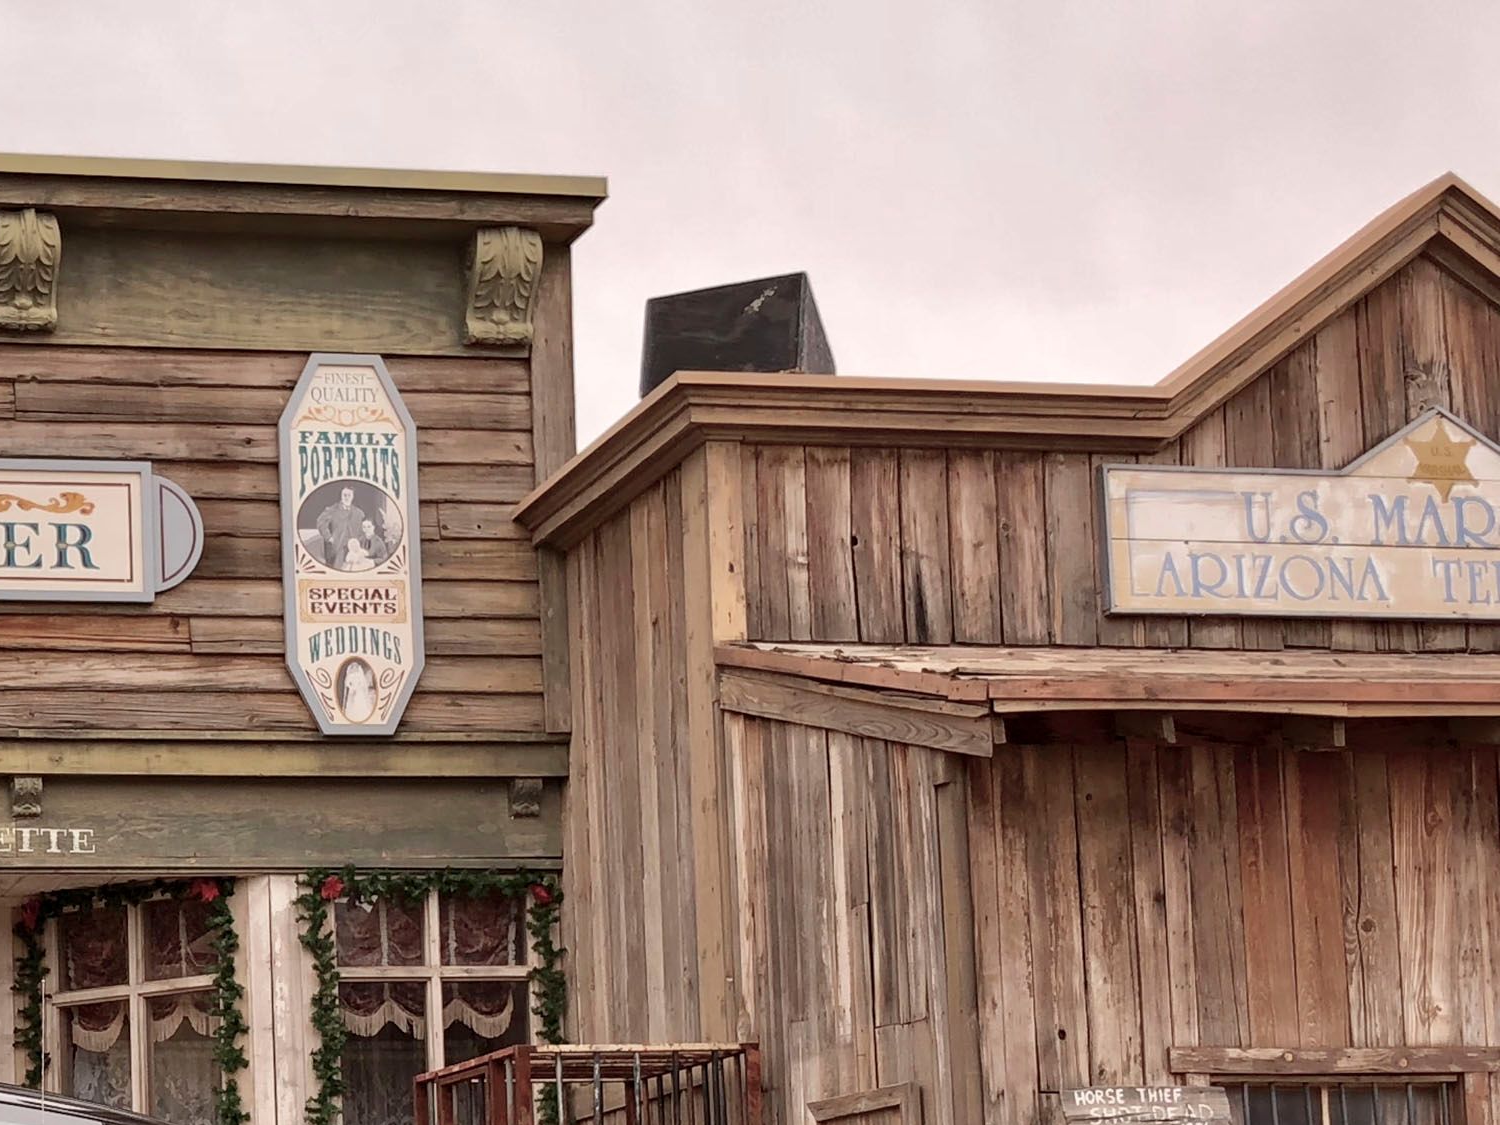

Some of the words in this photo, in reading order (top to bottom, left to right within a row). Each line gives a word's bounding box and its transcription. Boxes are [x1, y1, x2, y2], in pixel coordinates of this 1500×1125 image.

[324, 372, 367, 386] FINEST
[310, 386, 379, 404] QUALITY
[299, 431, 399, 447] FAMILY
[298, 445, 400, 500] PORTRAITS
[1241, 490, 1339, 544] U.S.
[1367, 494, 1500, 548] MAR
[1155, 551, 1390, 601] ARIZONA
[309, 587, 397, 601] SPECIAL
[310, 601, 396, 616] EVENTS
[308, 625, 401, 665] WEDDINGS
[1074, 1088, 1125, 1106] HORSE
[1136, 1088, 1182, 1104] THIEF
[1152, 1103, 1214, 1125] DEAD
